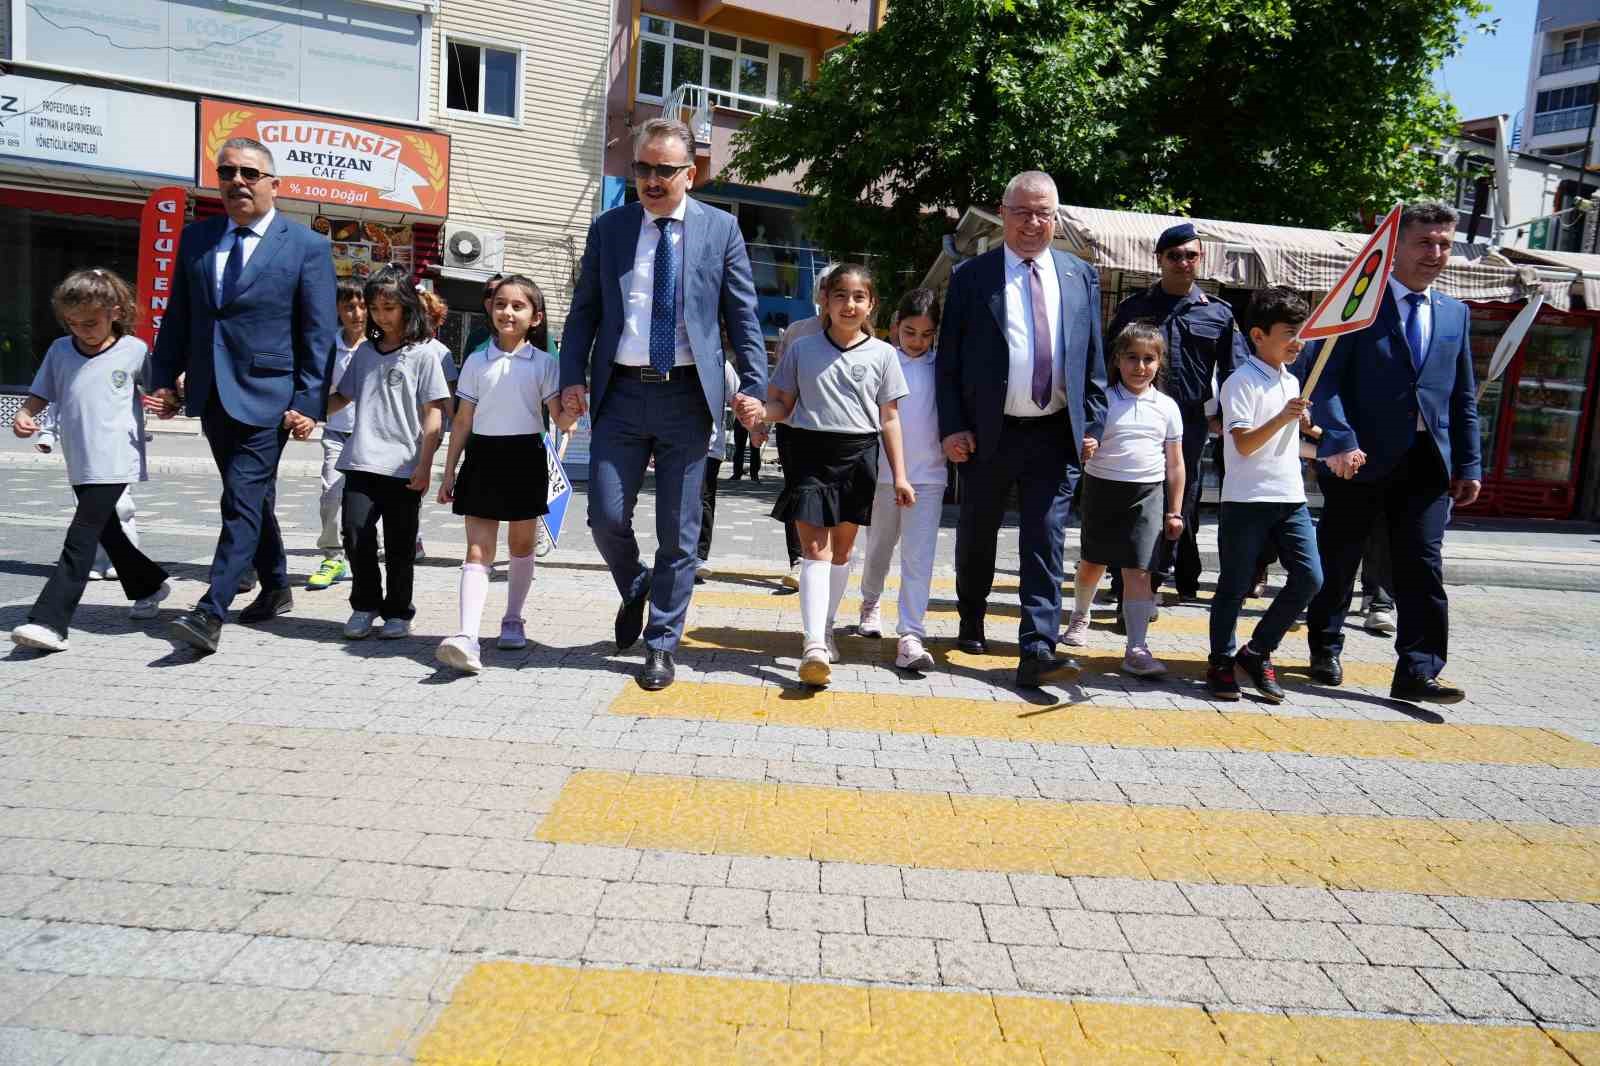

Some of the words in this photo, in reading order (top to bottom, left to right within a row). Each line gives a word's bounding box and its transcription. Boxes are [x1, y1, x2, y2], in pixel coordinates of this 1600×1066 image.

[42, 100, 79, 116] PROFESYONEL
[30, 115, 58, 131] APARTMAN
[261, 124, 402, 161] GLUTENSİZ
[286, 148, 372, 172] ARTİZAN
[312, 166, 345, 180] CAFE
[289, 183, 301, 194] %
[304, 186, 328, 197] 100
[330, 188, 368, 204] Doğal
[151, 200, 177, 347] GLUTENSİ
